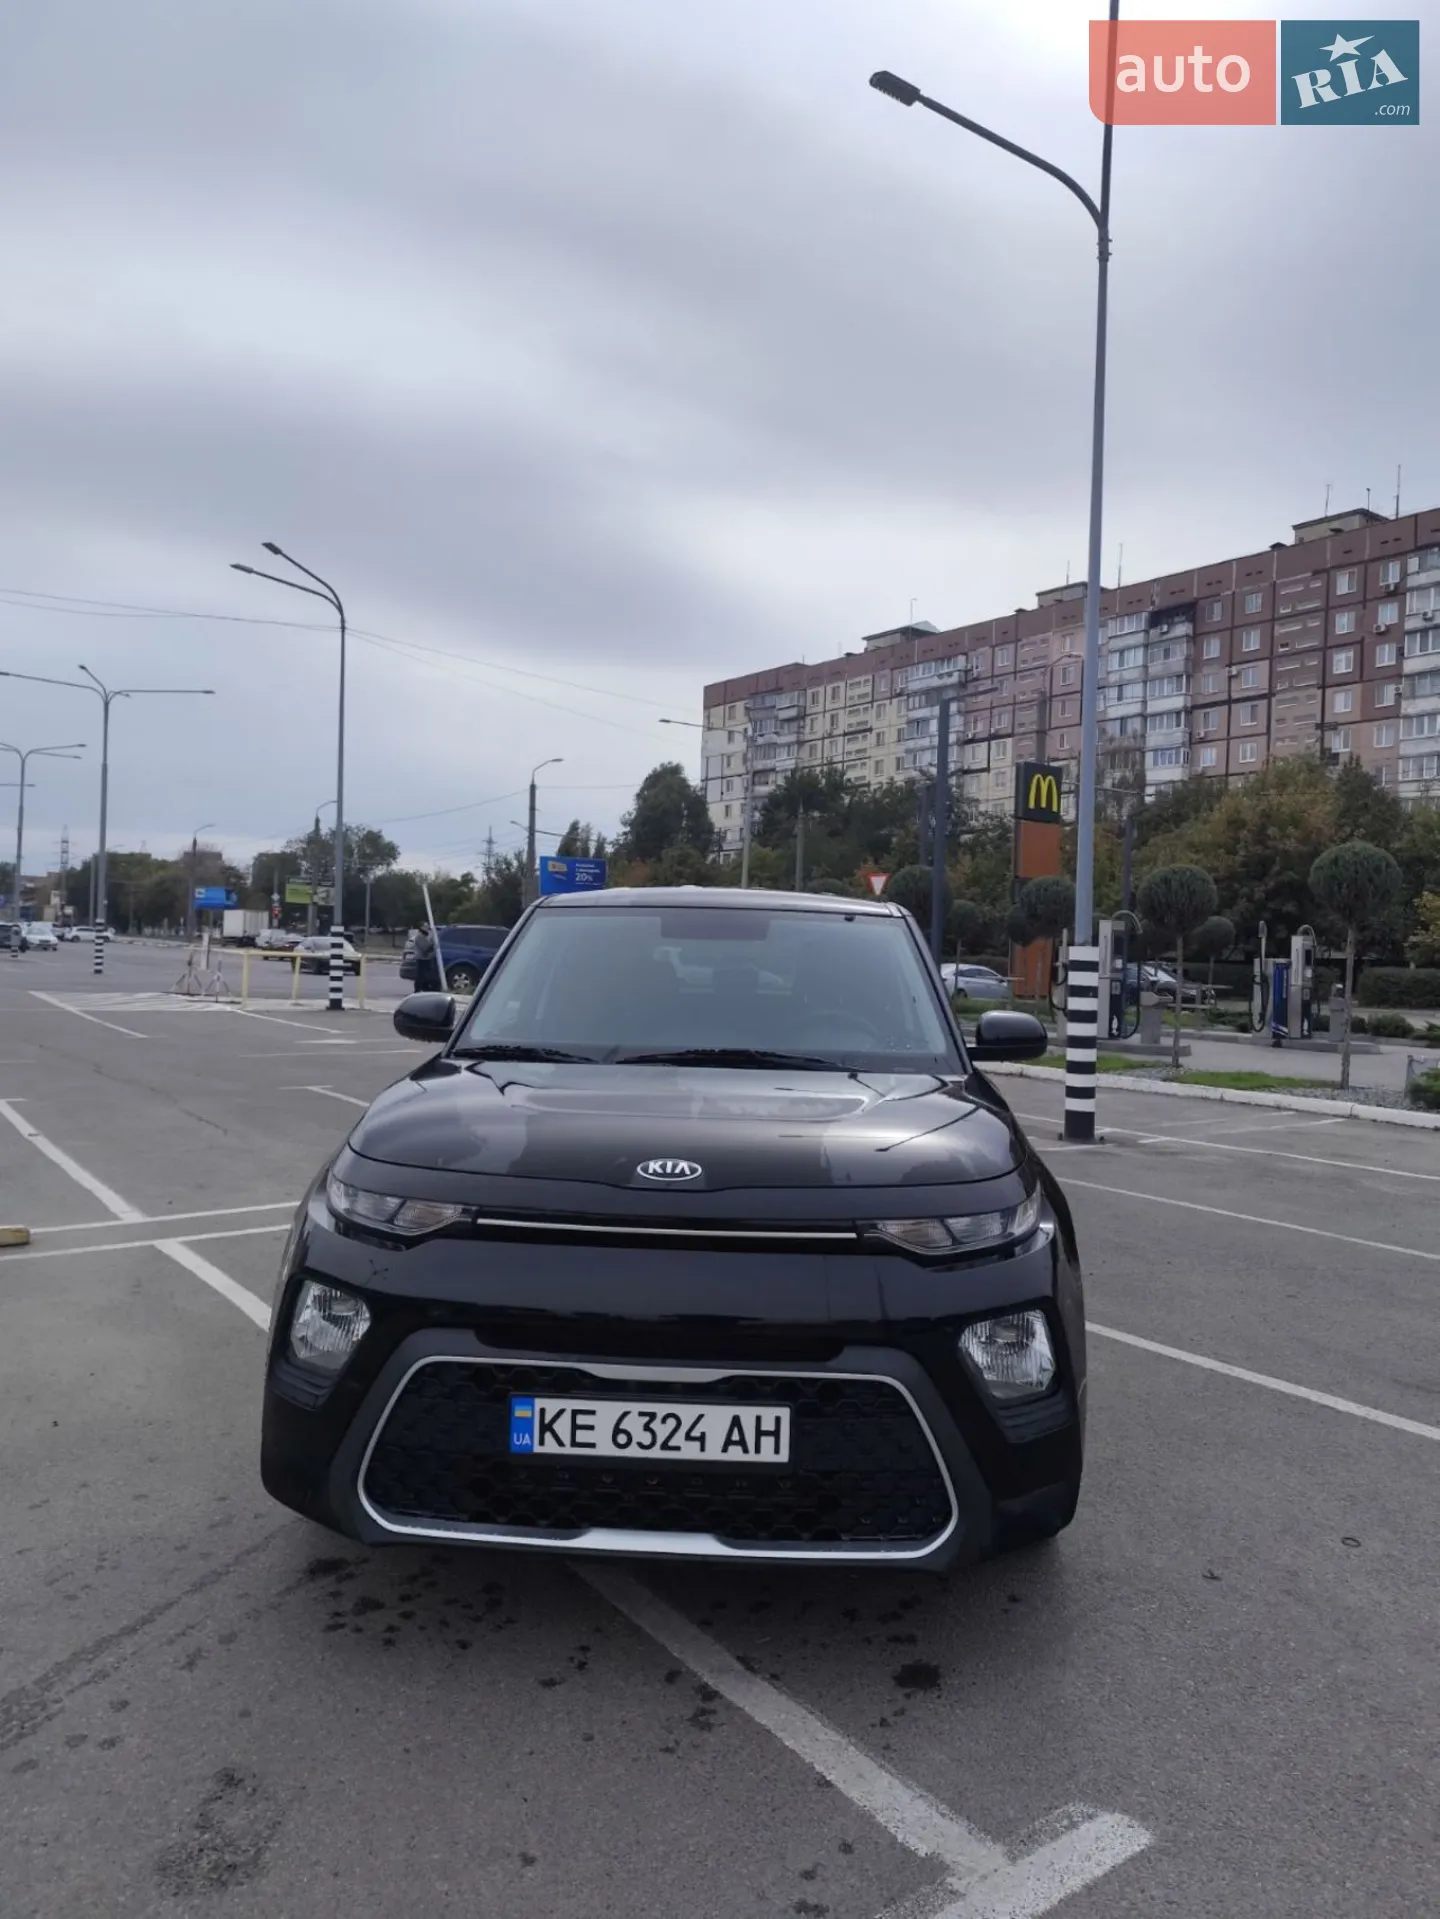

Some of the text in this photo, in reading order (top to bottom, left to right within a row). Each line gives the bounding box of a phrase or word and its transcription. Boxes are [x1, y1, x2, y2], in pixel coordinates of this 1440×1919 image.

[648, 1161, 691, 1175] KIA
[538, 1407, 782, 1455] KE 6324 AH
[513, 1432, 532, 1446] UA
